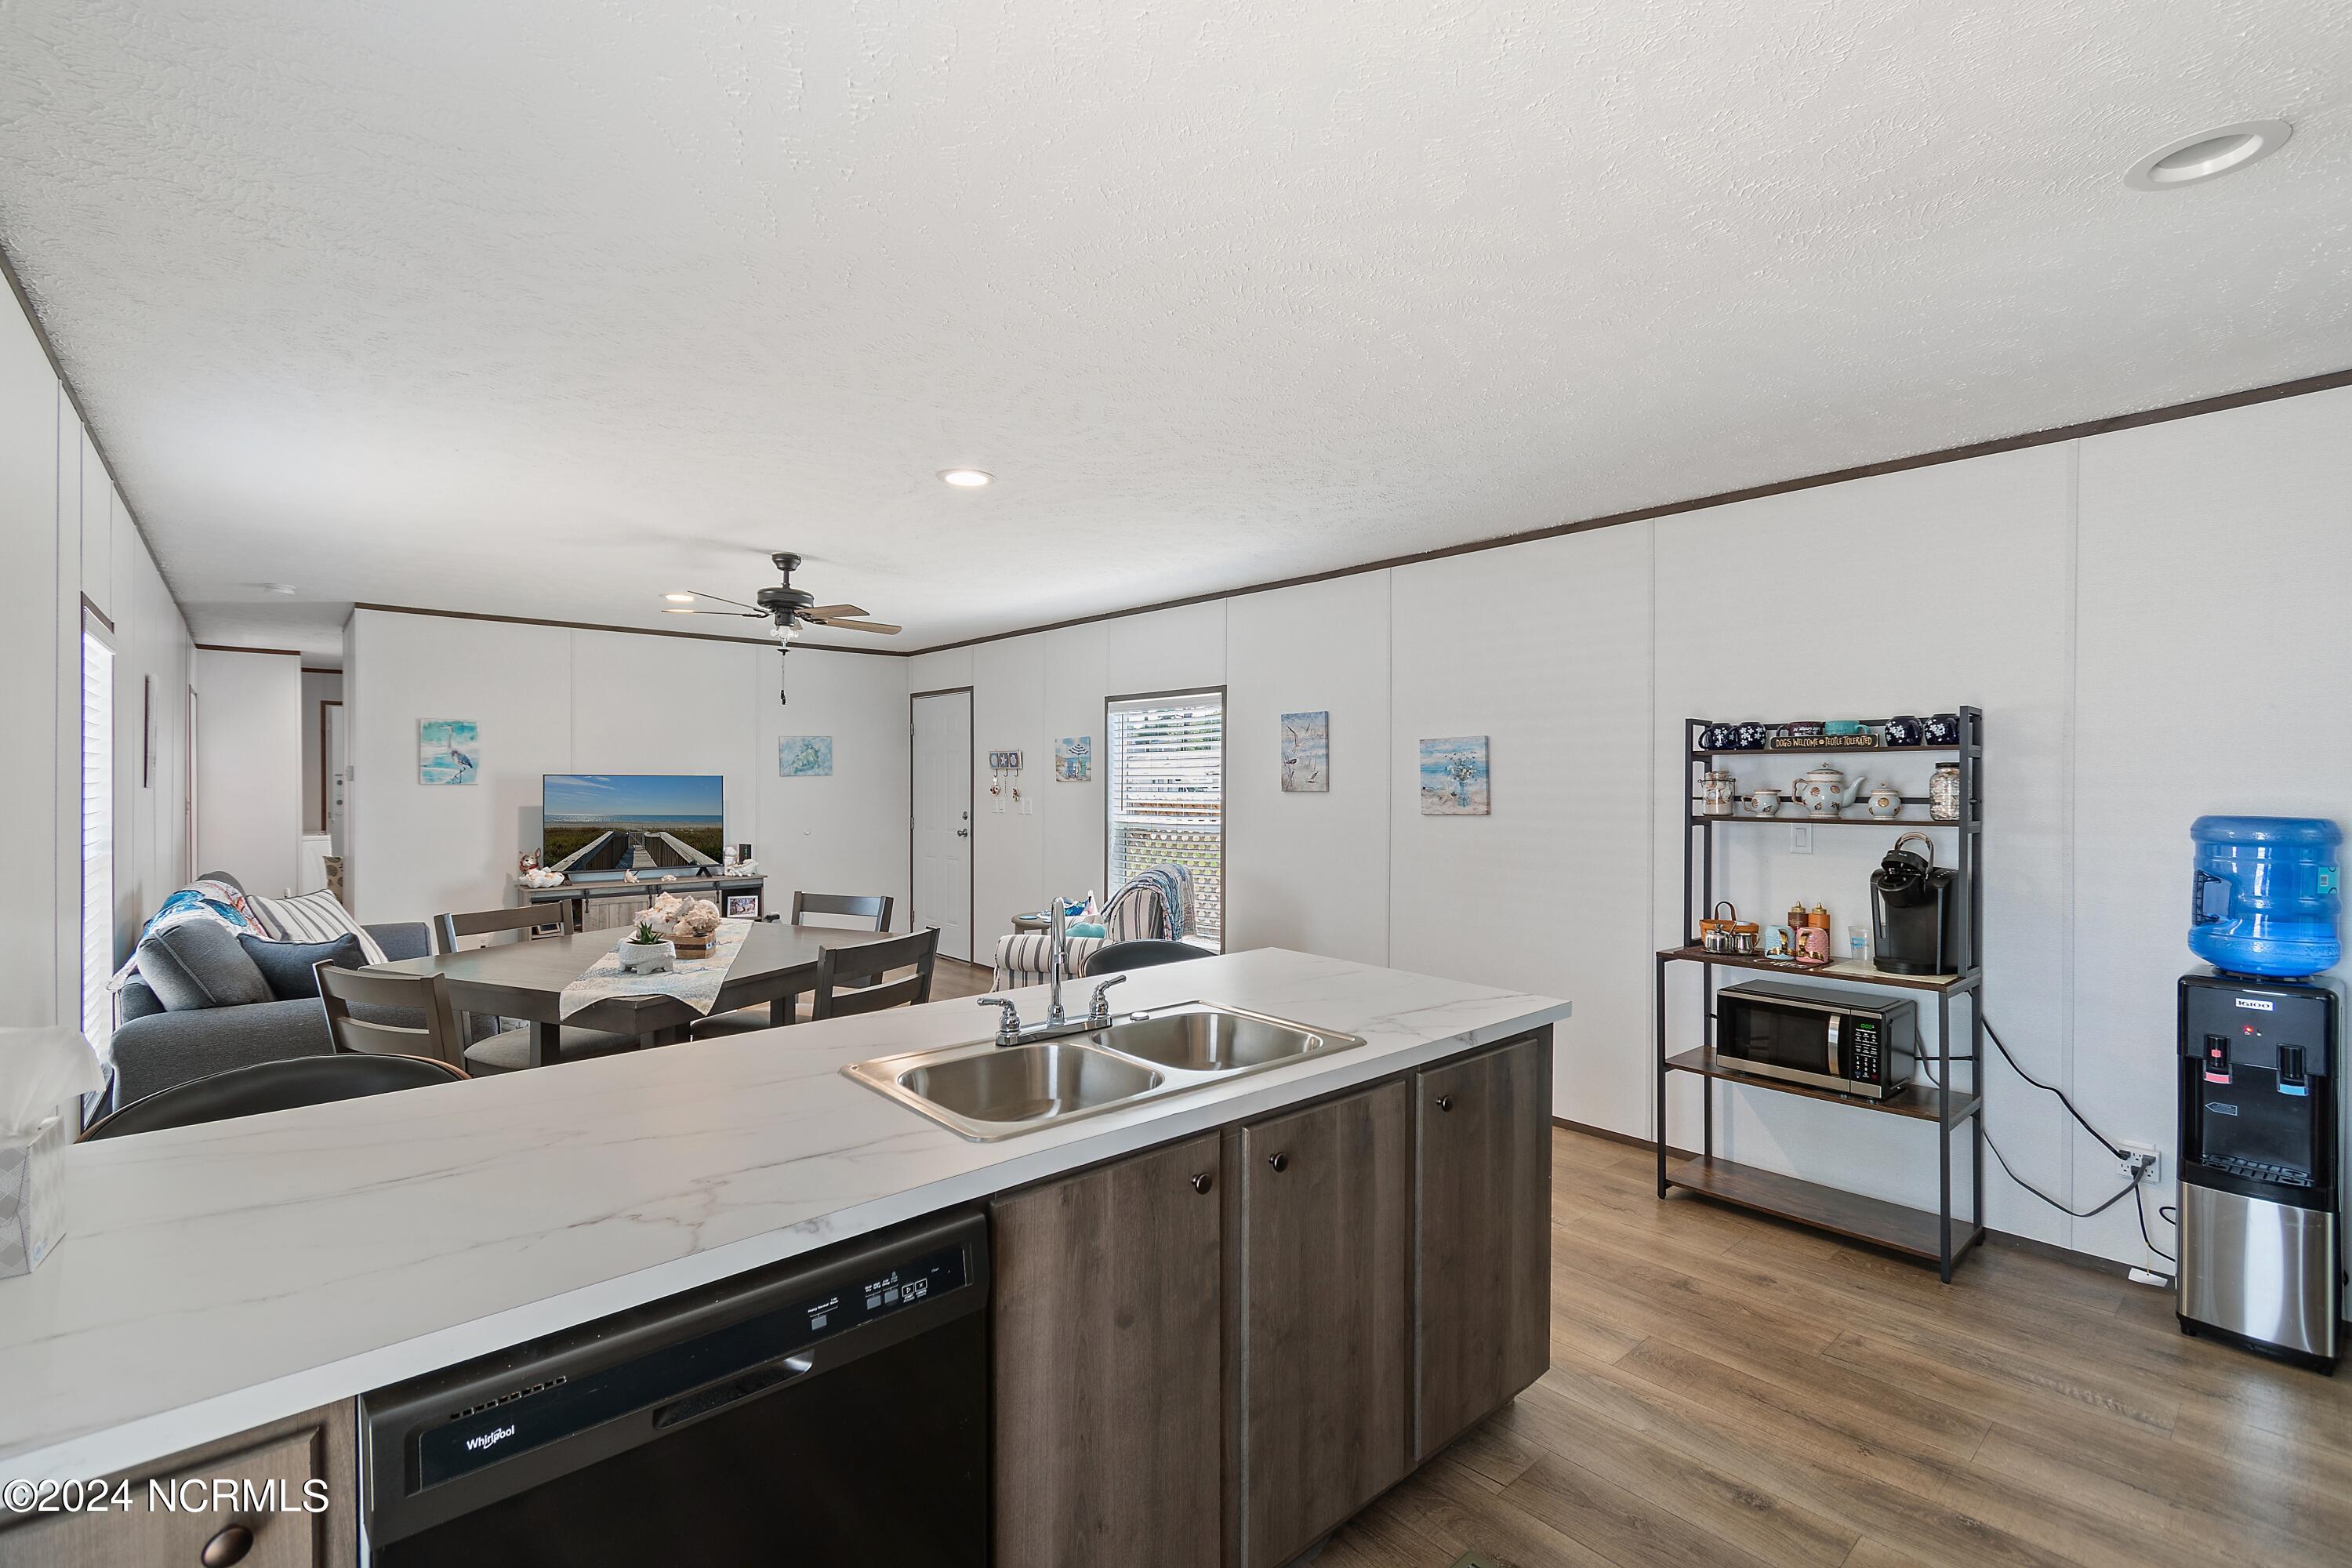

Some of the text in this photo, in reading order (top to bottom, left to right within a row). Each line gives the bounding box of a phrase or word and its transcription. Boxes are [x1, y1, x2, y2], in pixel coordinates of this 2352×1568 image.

[1793, 738, 1818, 746] WELCOME
[1825, 737, 1842, 746] PEOPLE
[1842, 735, 1872, 746] TOLERATED
[466, 1425, 515, 1450] Whirlpool
